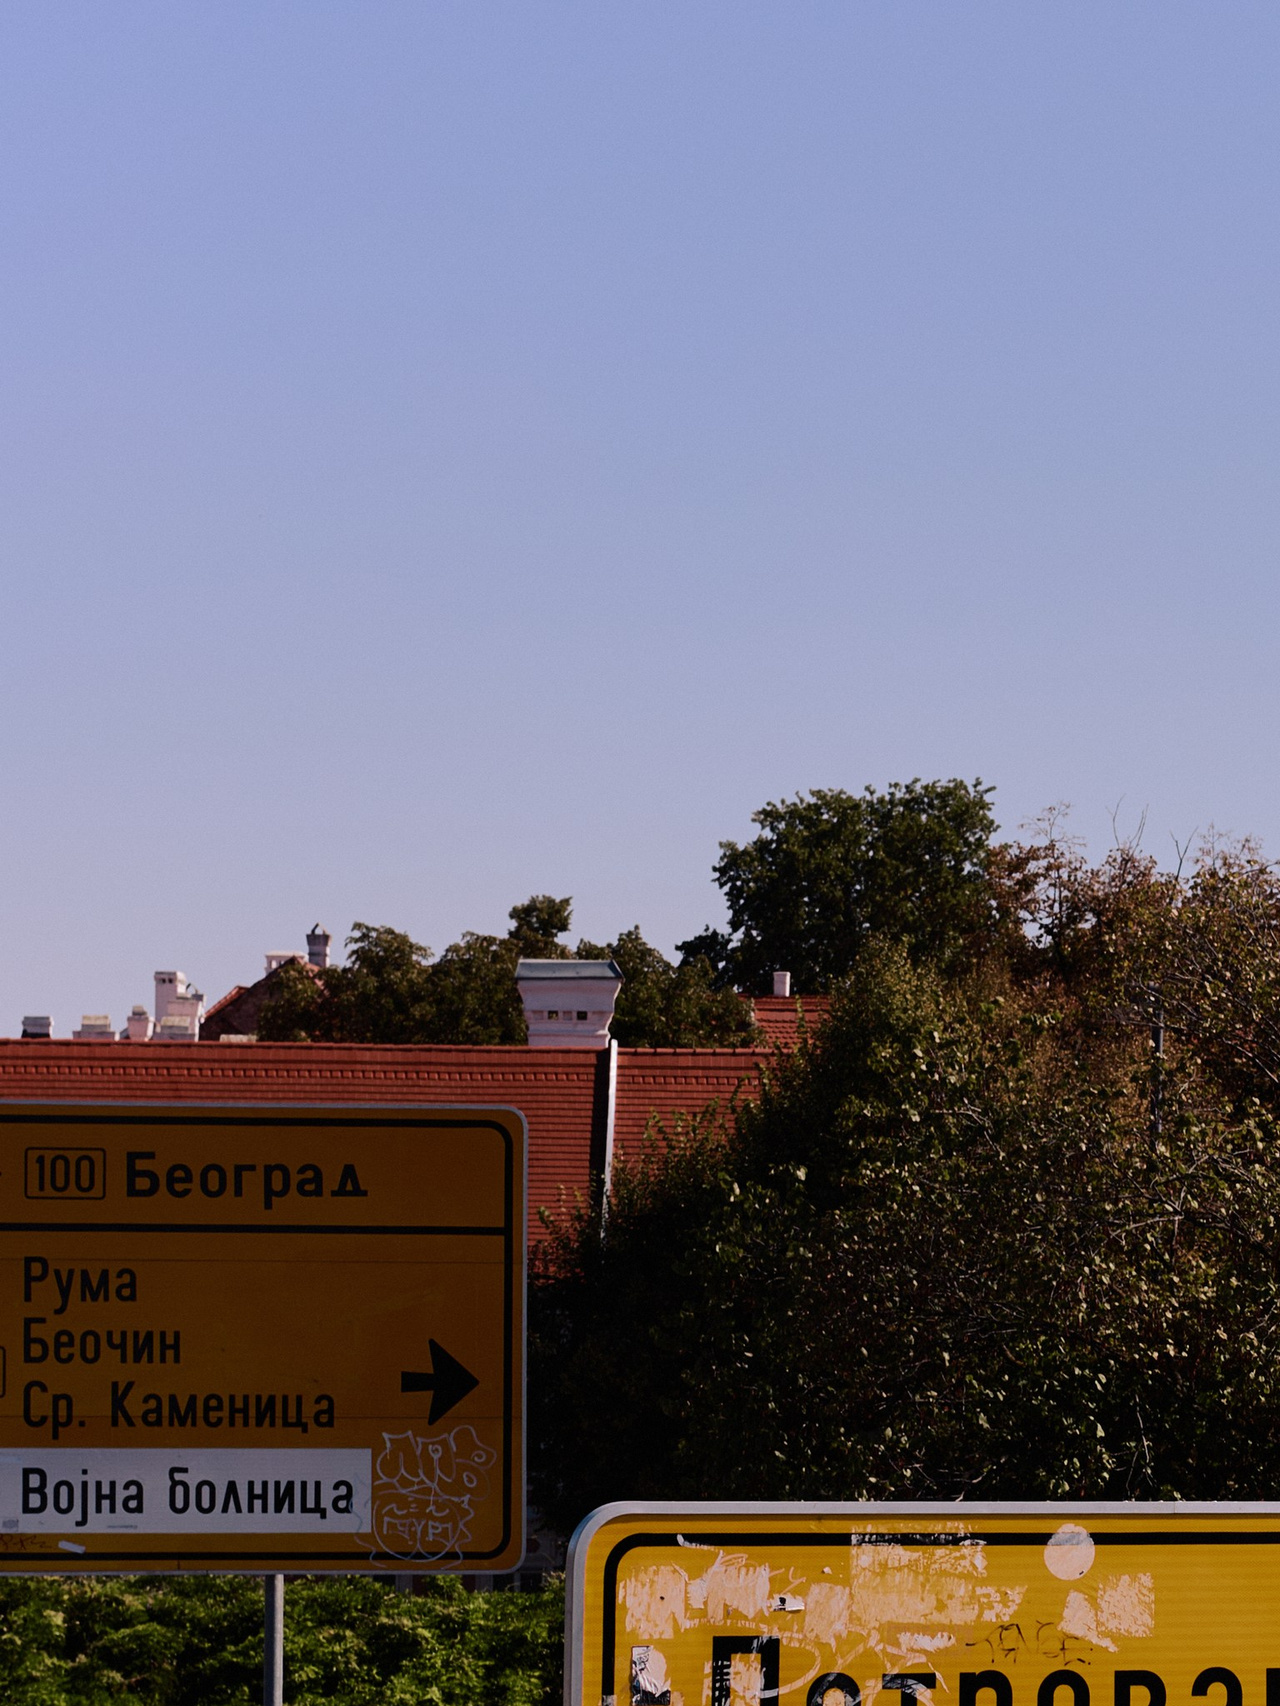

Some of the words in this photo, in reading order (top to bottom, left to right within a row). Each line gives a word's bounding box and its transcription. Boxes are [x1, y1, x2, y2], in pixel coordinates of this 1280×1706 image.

[35, 1154, 96, 1193] 100
[126, 1151, 368, 1211] Београд
[23, 1256, 137, 1315] Рума
[23, 1317, 181, 1365] Беочин
[23, 1381, 86, 1440] Ср.
[111, 1381, 335, 1434] Каменица
[21, 1467, 144, 1527] Војна
[169, 1466, 354, 1520] болница
